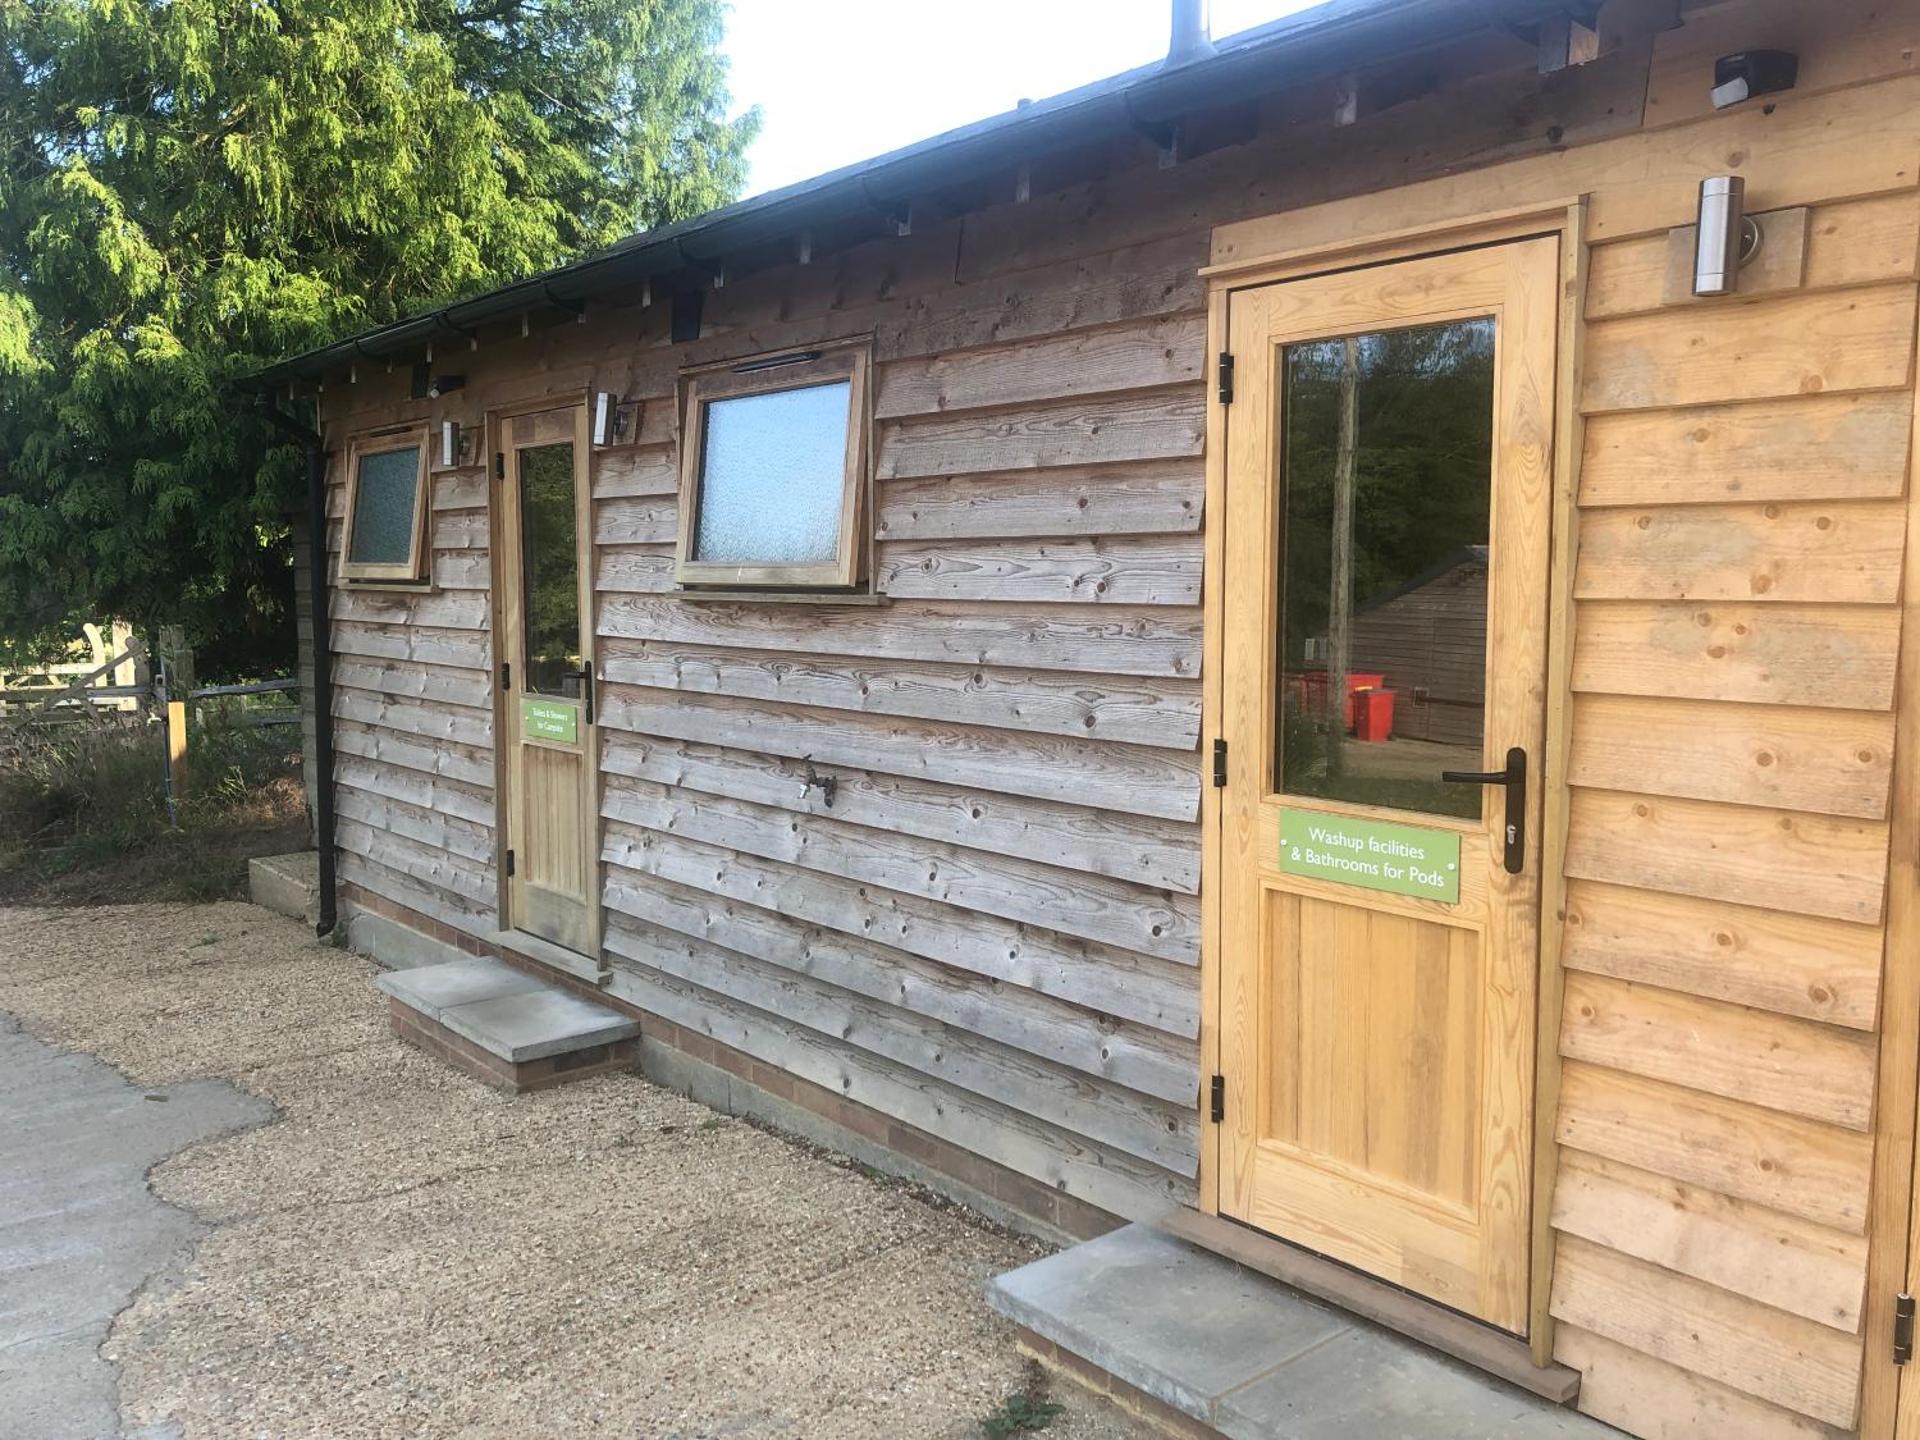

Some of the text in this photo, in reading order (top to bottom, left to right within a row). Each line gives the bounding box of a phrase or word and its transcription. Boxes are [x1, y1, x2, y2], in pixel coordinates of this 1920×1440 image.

[1308, 826, 1425, 860] Washup facilities
[1291, 846, 1445, 887] & Bathrooms for Pods
